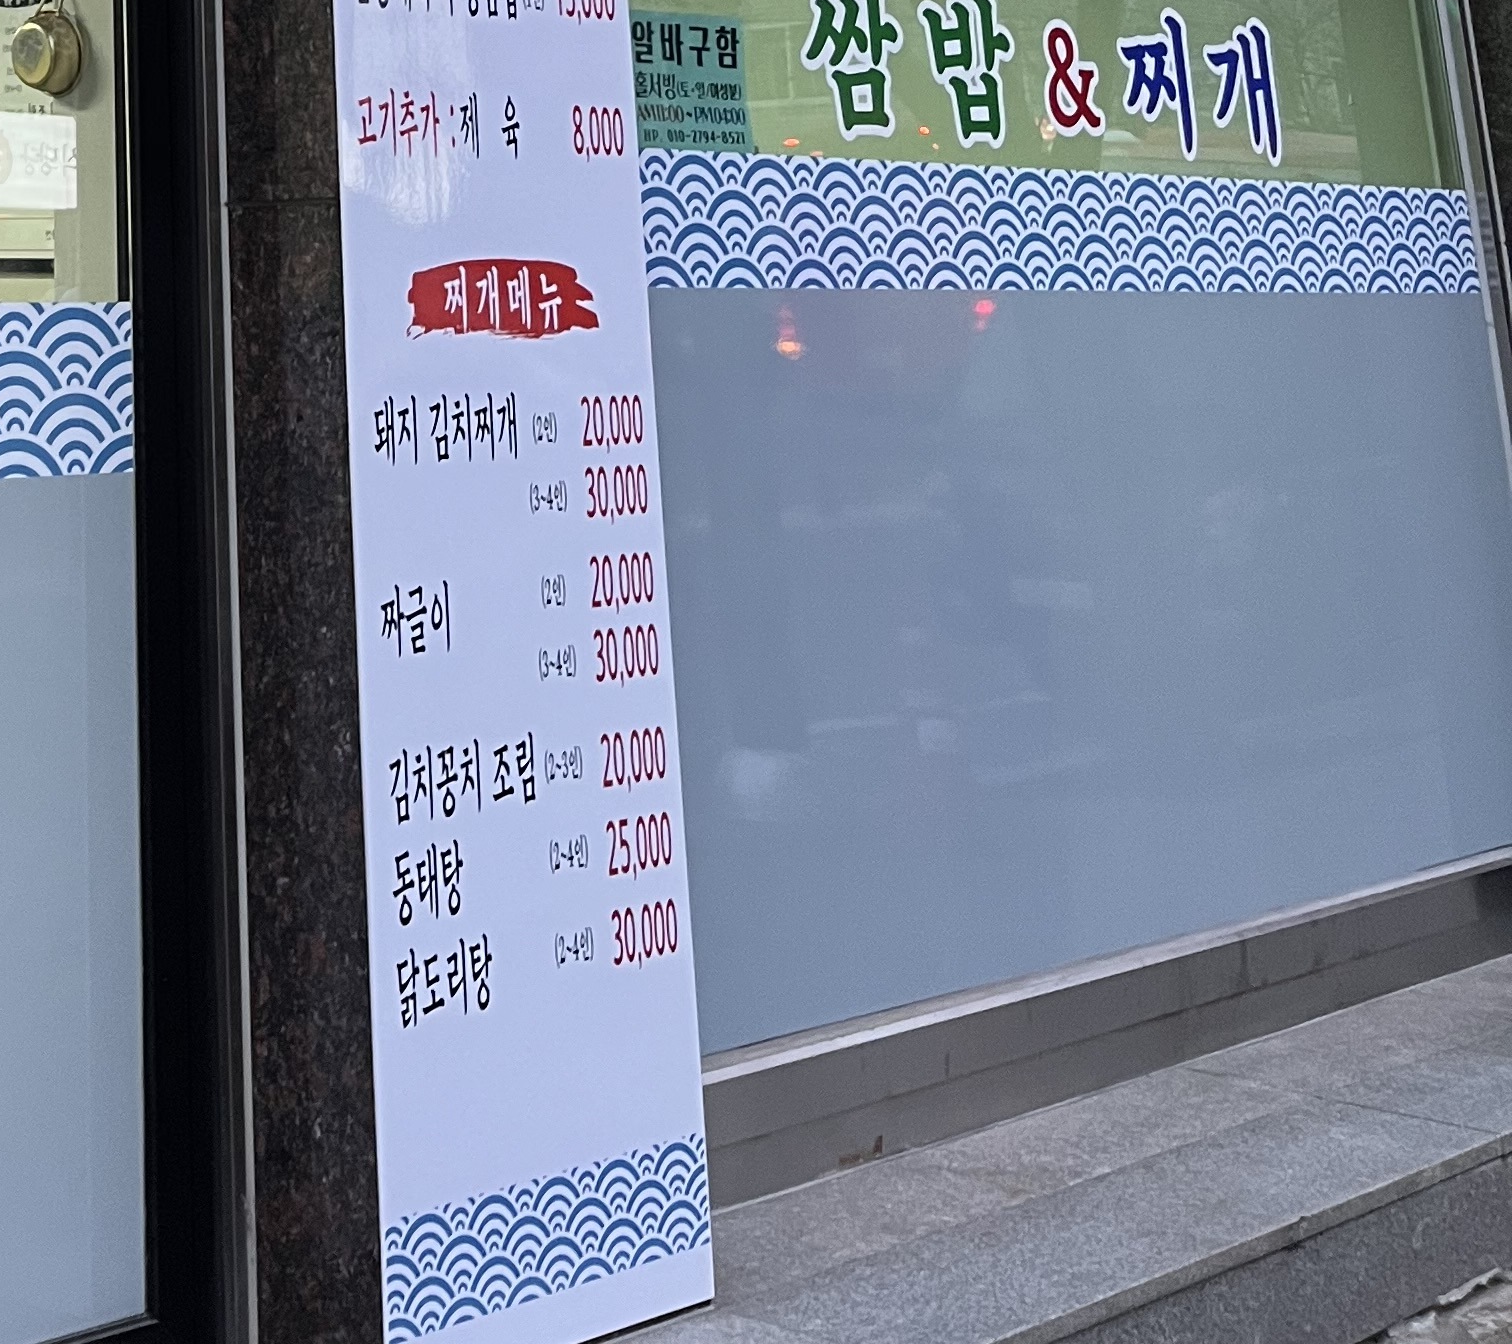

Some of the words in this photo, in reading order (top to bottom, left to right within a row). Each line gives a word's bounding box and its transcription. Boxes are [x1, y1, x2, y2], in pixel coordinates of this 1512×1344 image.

[631, 20, 740, 70] 알바구함
[1046, 25, 1103, 134] &
[1119, 10, 1281, 164] 찌개
[572, 104, 625, 163] 8,000
[373, 394, 418, 467] 돼지
[428, 391, 518, 463] 김치찌개
[531, 411, 558, 446] (2인)
[580, 394, 644, 454] 20,000
[584, 463, 648, 526] 30,000
[380, 579, 451, 659] 짜글이
[540, 573, 567, 610] (2인)
[589, 551, 654, 615] 20,000
[593, 623, 659, 688] 30,000
[388, 737, 482, 827] 김치꽁치
[492, 730, 537, 805] 조림
[600, 725, 667, 793] 20,000
[392, 838, 464, 927] 동태탕
[605, 811, 673, 881] 25,000
[396, 932, 493, 1029] 닭도리탕
[610, 897, 679, 971] 30,000
